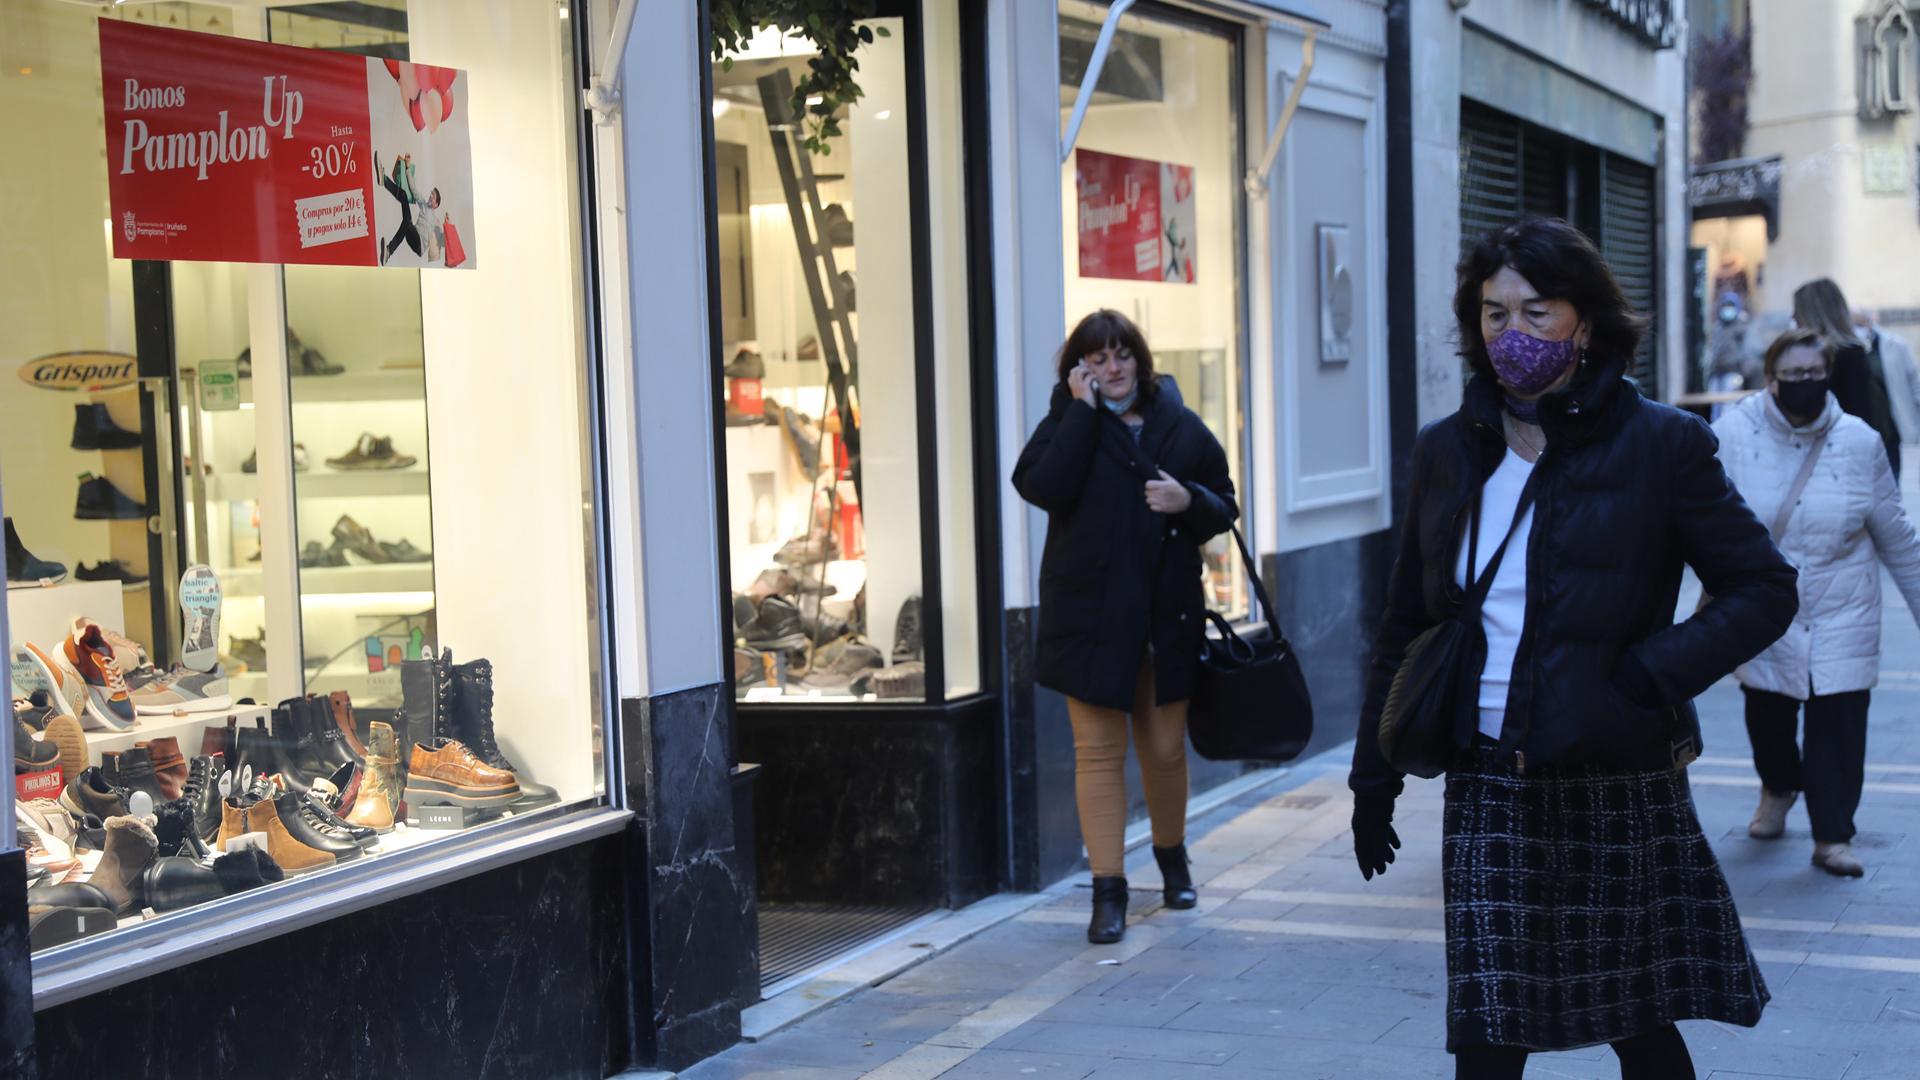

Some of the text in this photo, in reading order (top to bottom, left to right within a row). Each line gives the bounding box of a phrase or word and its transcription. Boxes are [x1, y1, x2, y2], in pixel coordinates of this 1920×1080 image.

[123, 79, 185, 111] Bonos
[263, 75, 303, 139] Up
[331, 125, 353, 137] Hasta
[302, 141, 357, 179] -30%
[302, 207, 332, 220] Compras
[333, 204, 344, 216] por
[345, 197, 355, 211] 20
[313, 223, 333, 238] pagas
[334, 218, 347, 231] solo
[348, 215, 356, 228] 14
[33, 362, 134, 383] Grisport
[184, 579, 208, 587] baltic
[185, 594, 218, 603] triangle
